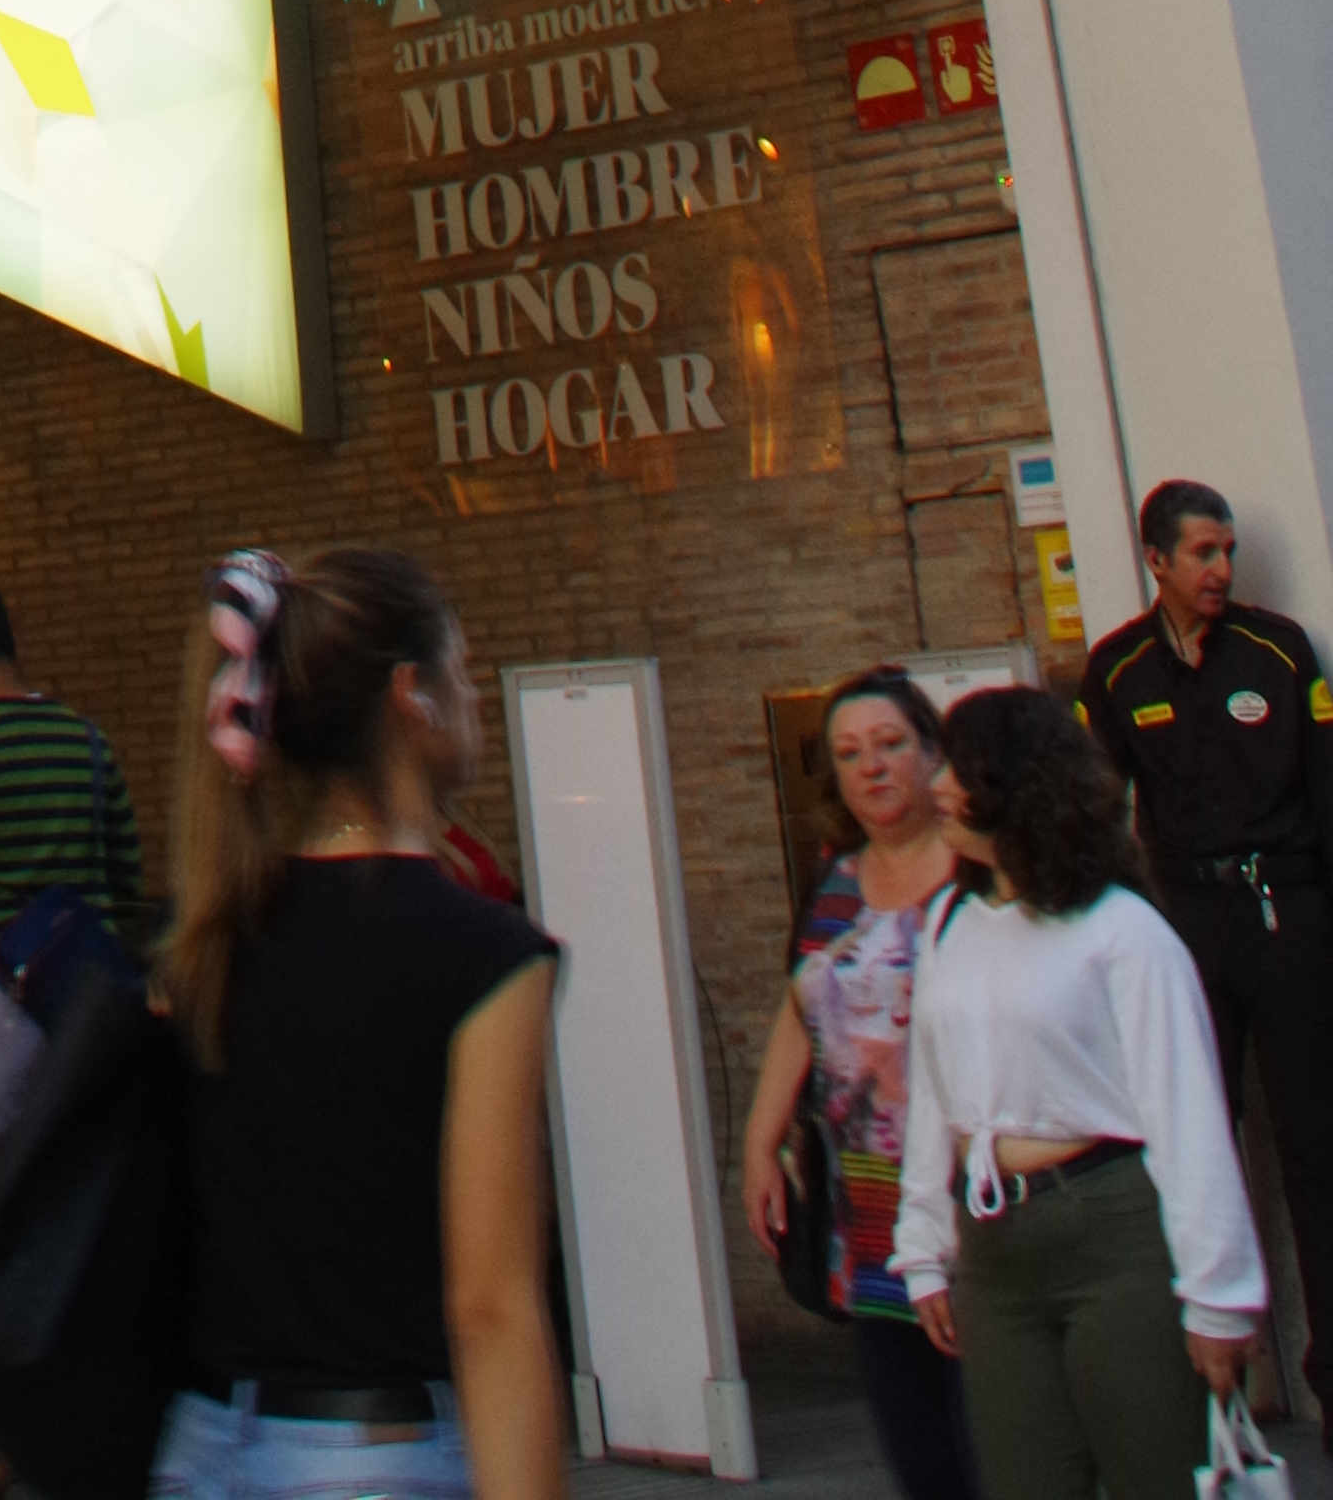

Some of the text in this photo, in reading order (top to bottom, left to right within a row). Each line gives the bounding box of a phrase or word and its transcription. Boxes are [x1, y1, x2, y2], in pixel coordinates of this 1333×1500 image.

[393, 15, 515, 74] arriba
[399, 41, 672, 162] MUJER
[409, 125, 763, 262] HOMBRE
[421, 252, 658, 364] NIÑOS
[433, 352, 726, 466] HOGAR
